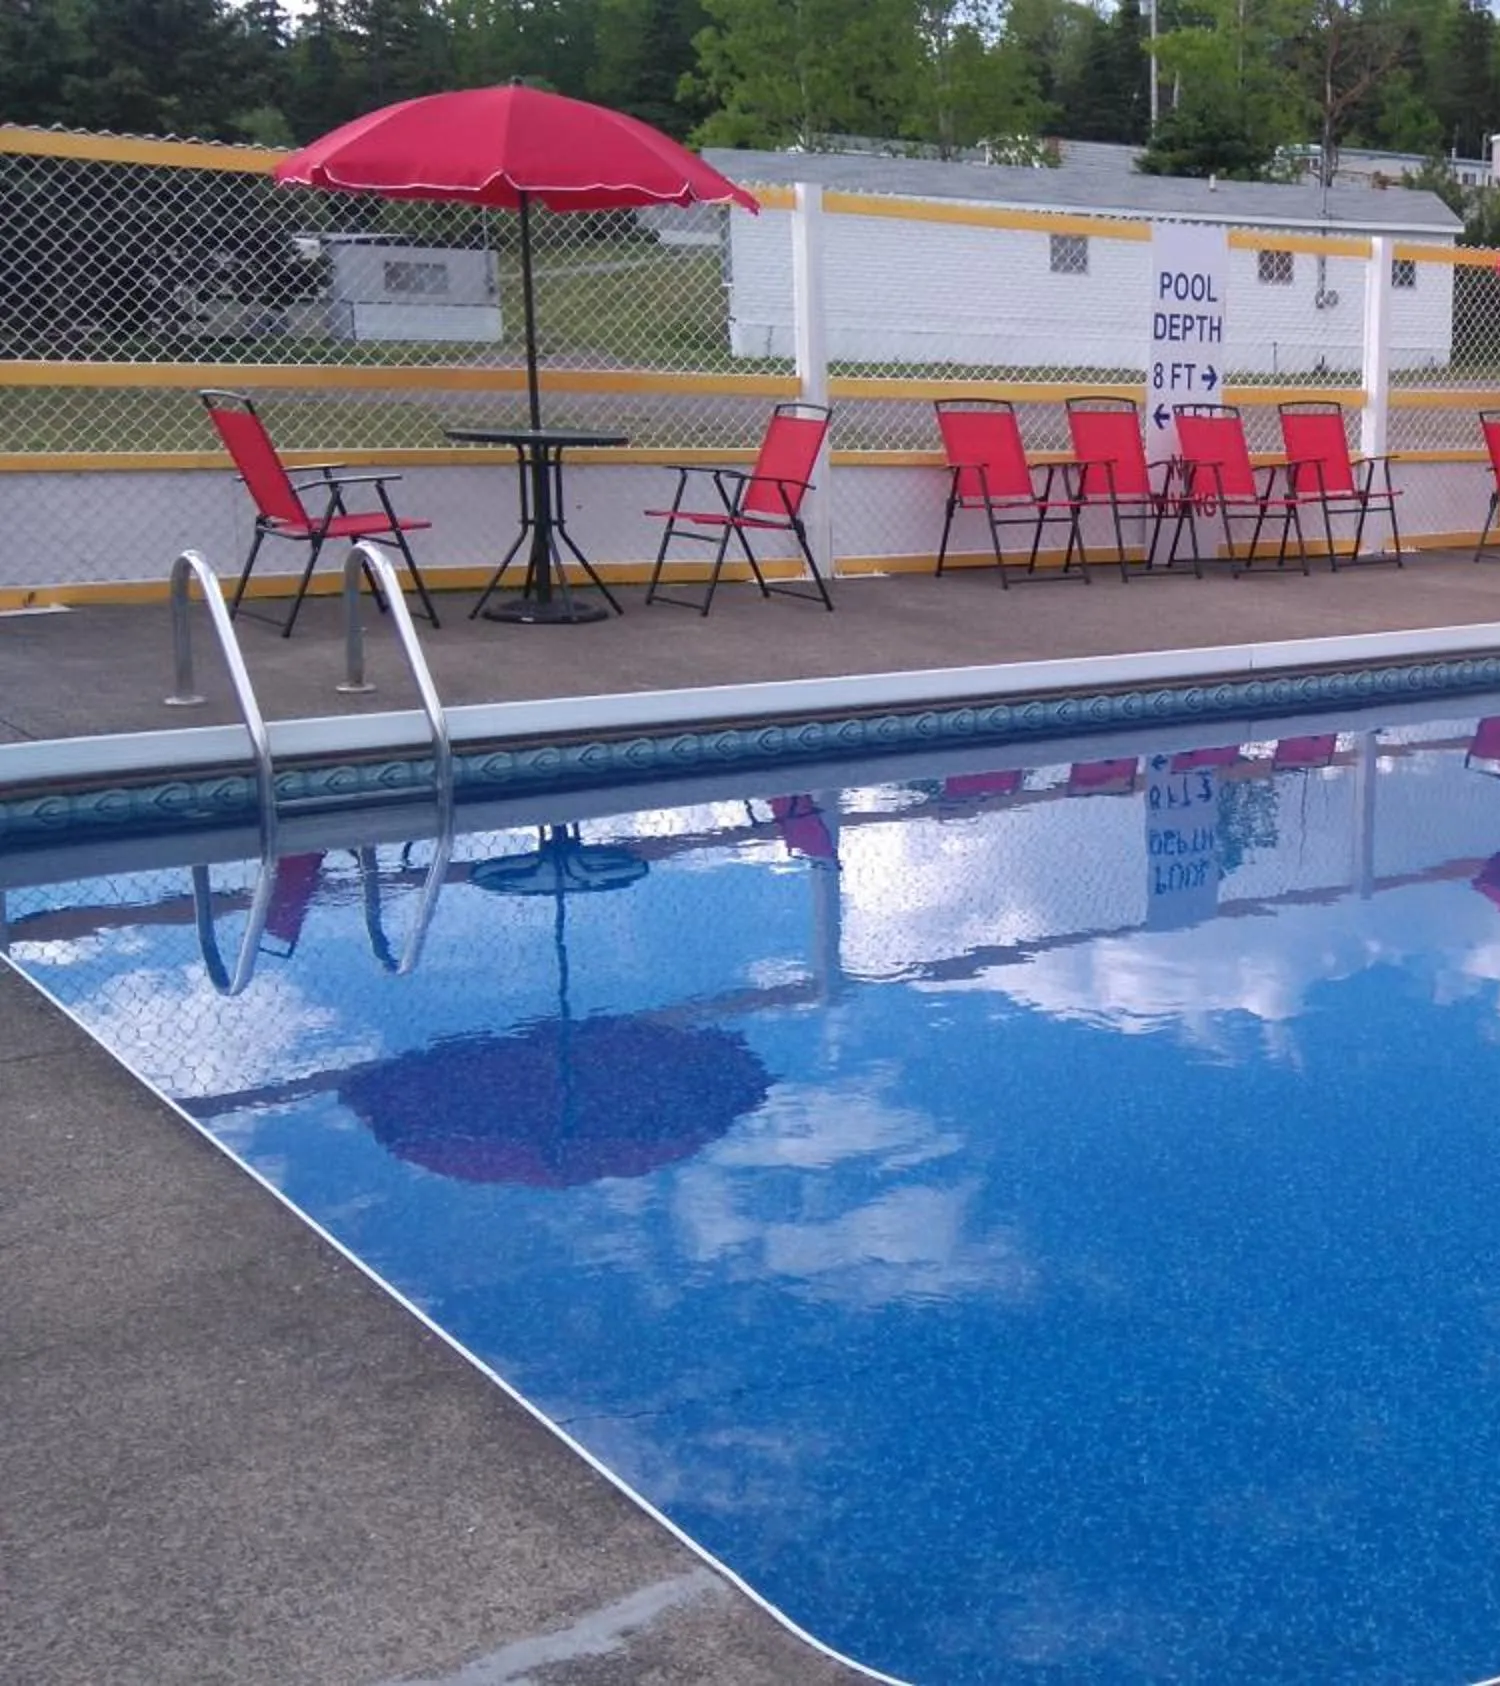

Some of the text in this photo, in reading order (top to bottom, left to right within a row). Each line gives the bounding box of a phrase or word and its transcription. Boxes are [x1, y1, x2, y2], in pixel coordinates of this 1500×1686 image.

[1160, 271, 1218, 302] POOL
[1153, 312, 1222, 343] DEPTH
[1153, 361, 1196, 391] 8 FT
